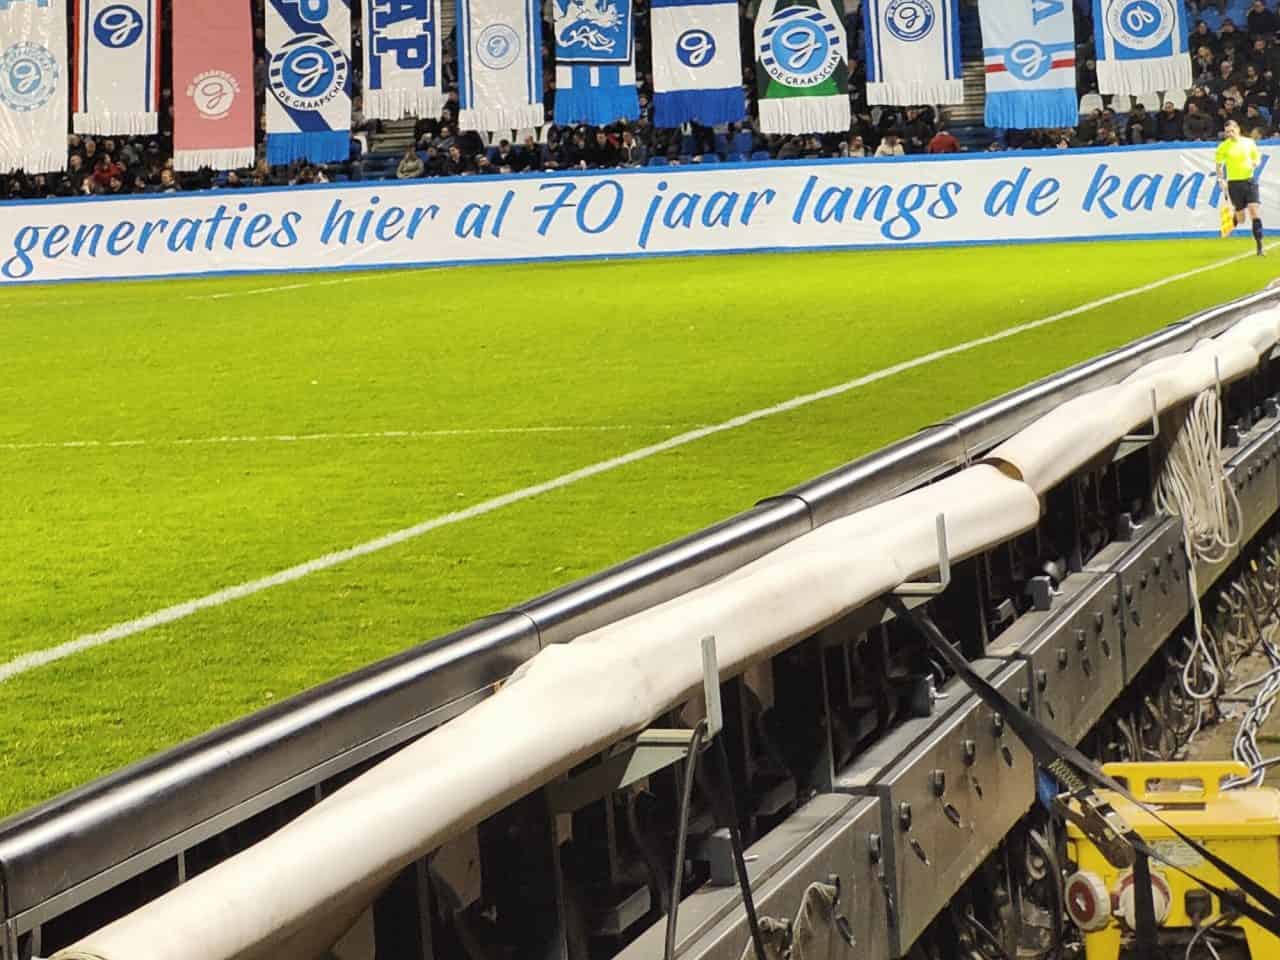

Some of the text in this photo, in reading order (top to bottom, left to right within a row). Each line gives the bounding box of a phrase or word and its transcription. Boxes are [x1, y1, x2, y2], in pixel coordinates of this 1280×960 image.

[0, 202, 303, 280] generaties
[320, 196, 440, 245] hier
[454, 190, 516, 239] al
[533, 179, 625, 236] 70
[637, 180, 777, 250] jaar
[792, 175, 963, 241] langs
[983, 166, 1061, 218] de
